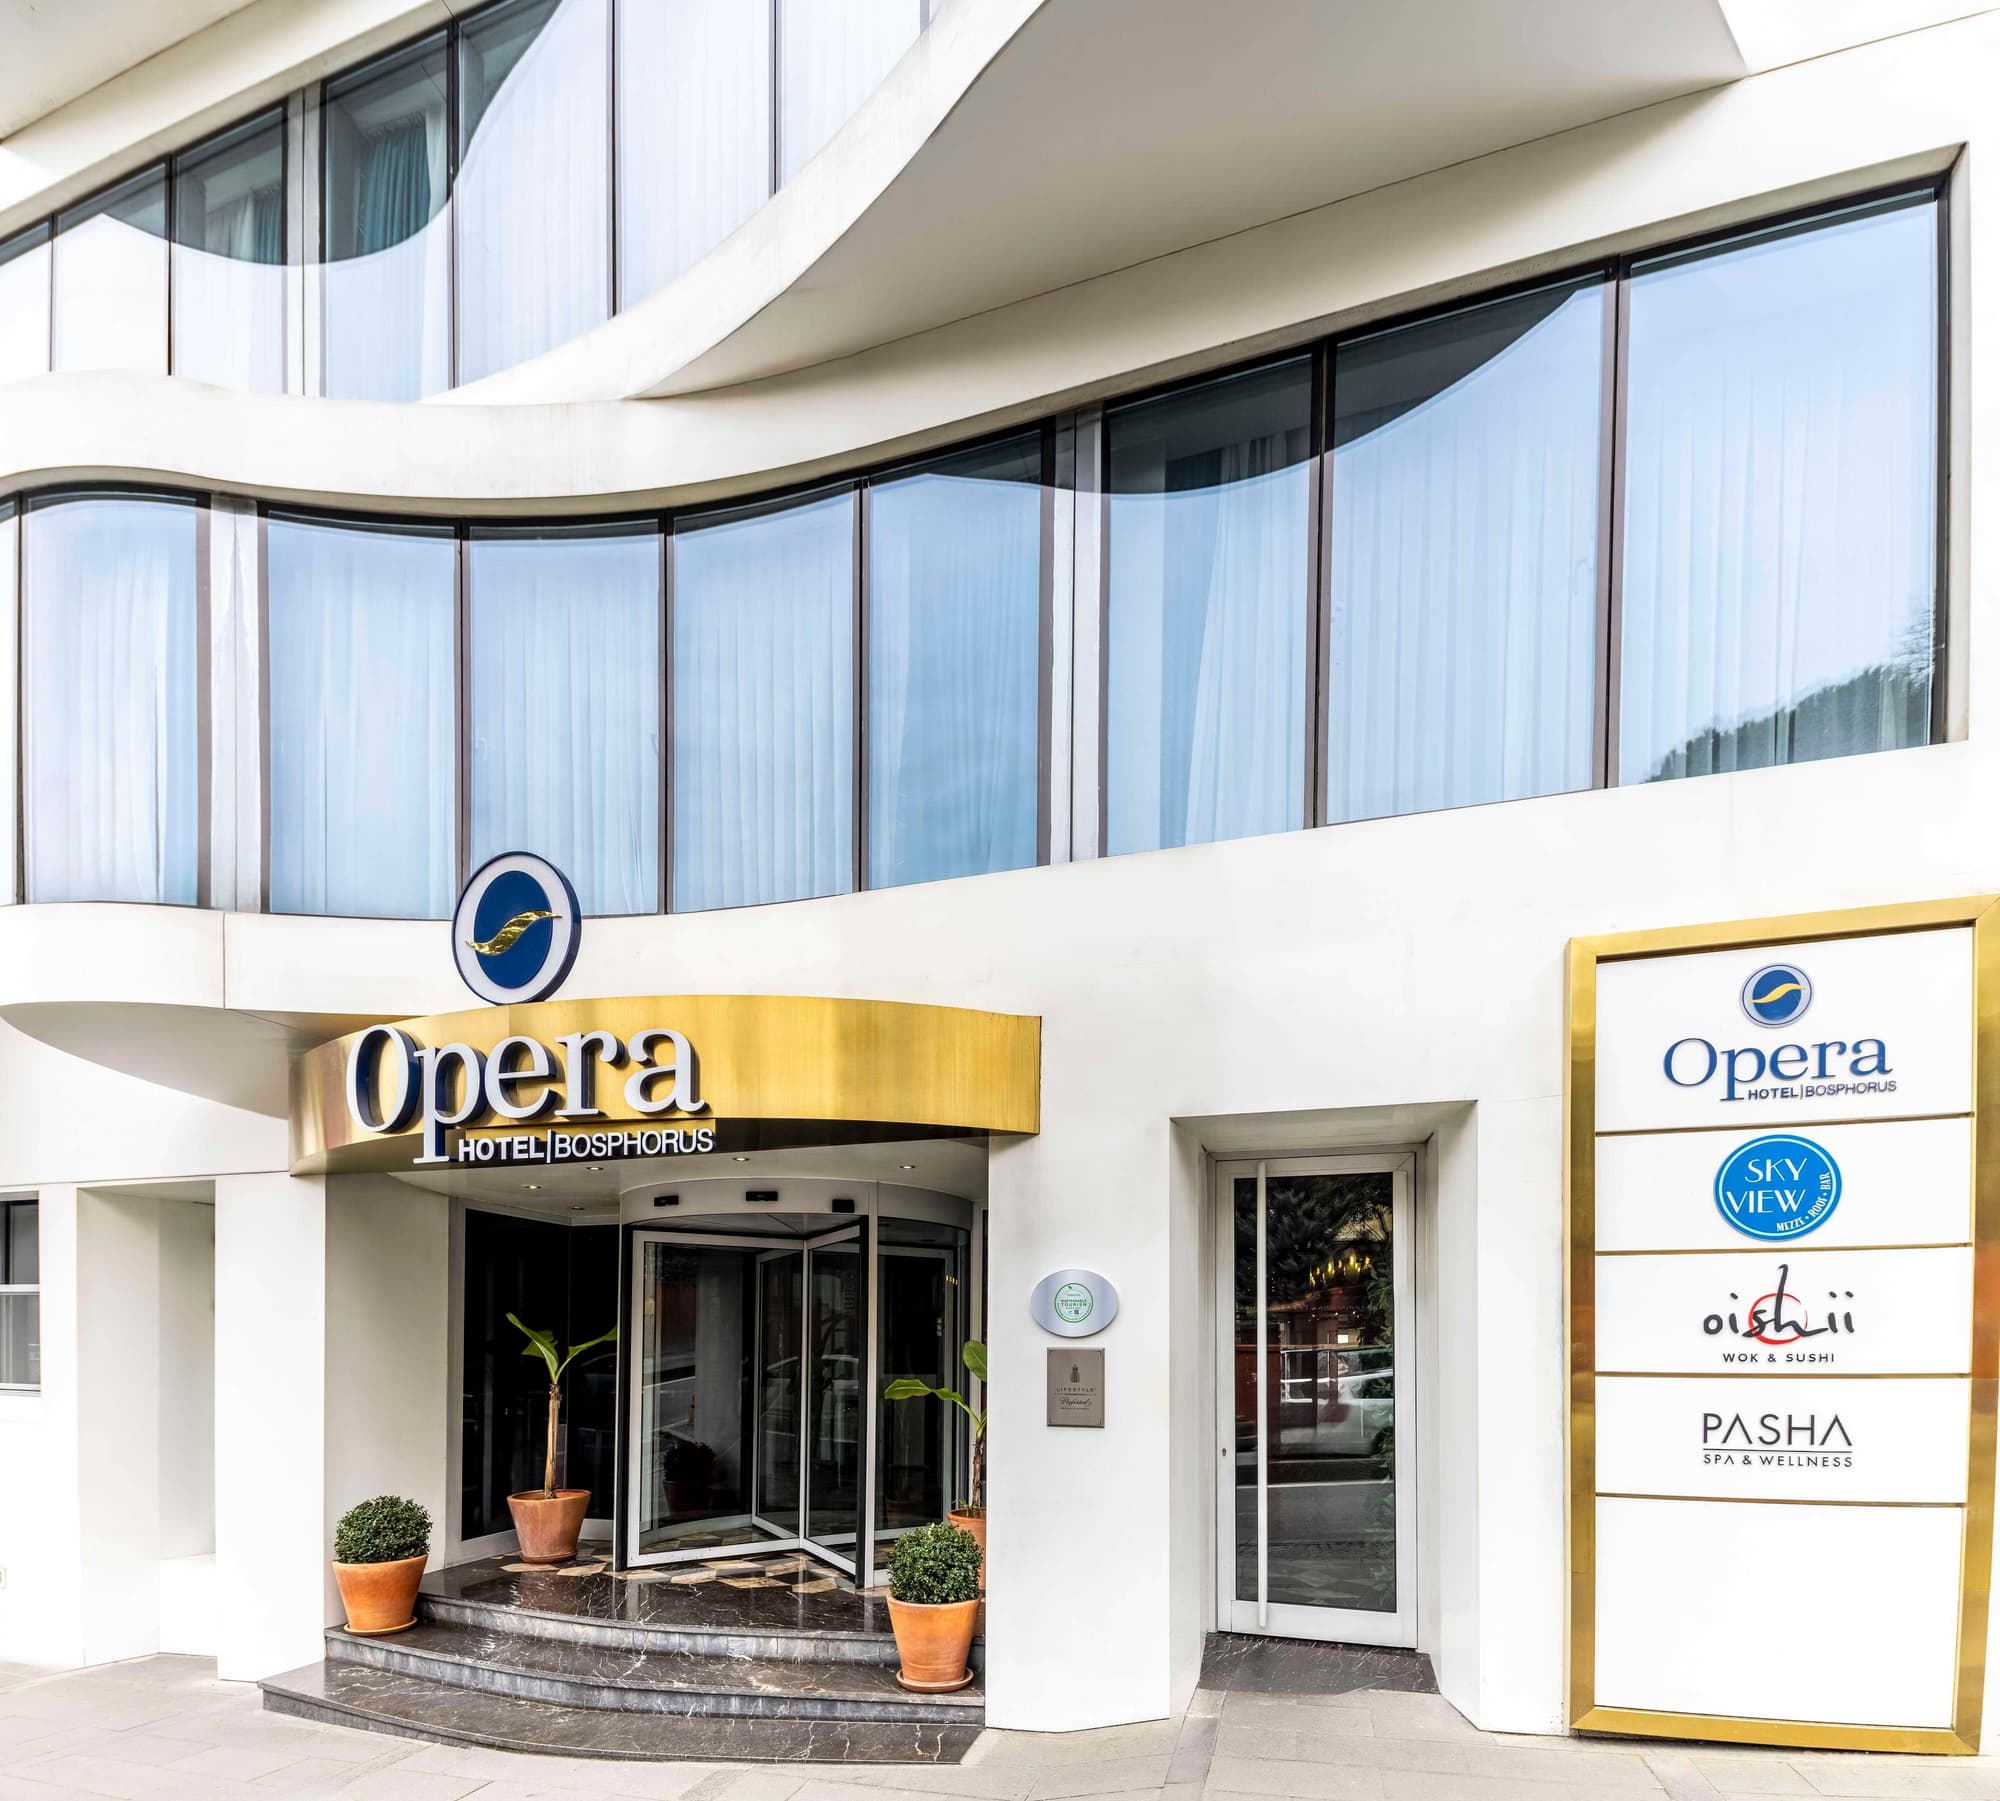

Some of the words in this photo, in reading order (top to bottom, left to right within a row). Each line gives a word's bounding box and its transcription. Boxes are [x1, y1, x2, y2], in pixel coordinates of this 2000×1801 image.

[1663, 1037, 1894, 1102] Opera
[346, 1024, 707, 1164] Opera
[1744, 1157, 1808, 1183] SKY
[1819, 1172, 1832, 1190] BAR
[1725, 1189, 1807, 1214] VIEW
[1722, 1353, 1759, 1363] WOK
[1767, 1353, 1777, 1363] &
[1785, 1353, 1835, 1363] SUSHI
[1702, 1412, 1853, 1447] PASHA
[1703, 1454, 1735, 1465] SPA
[1742, 1454, 1752, 1465] &
[1759, 1455, 1853, 1467] WELLNESS
